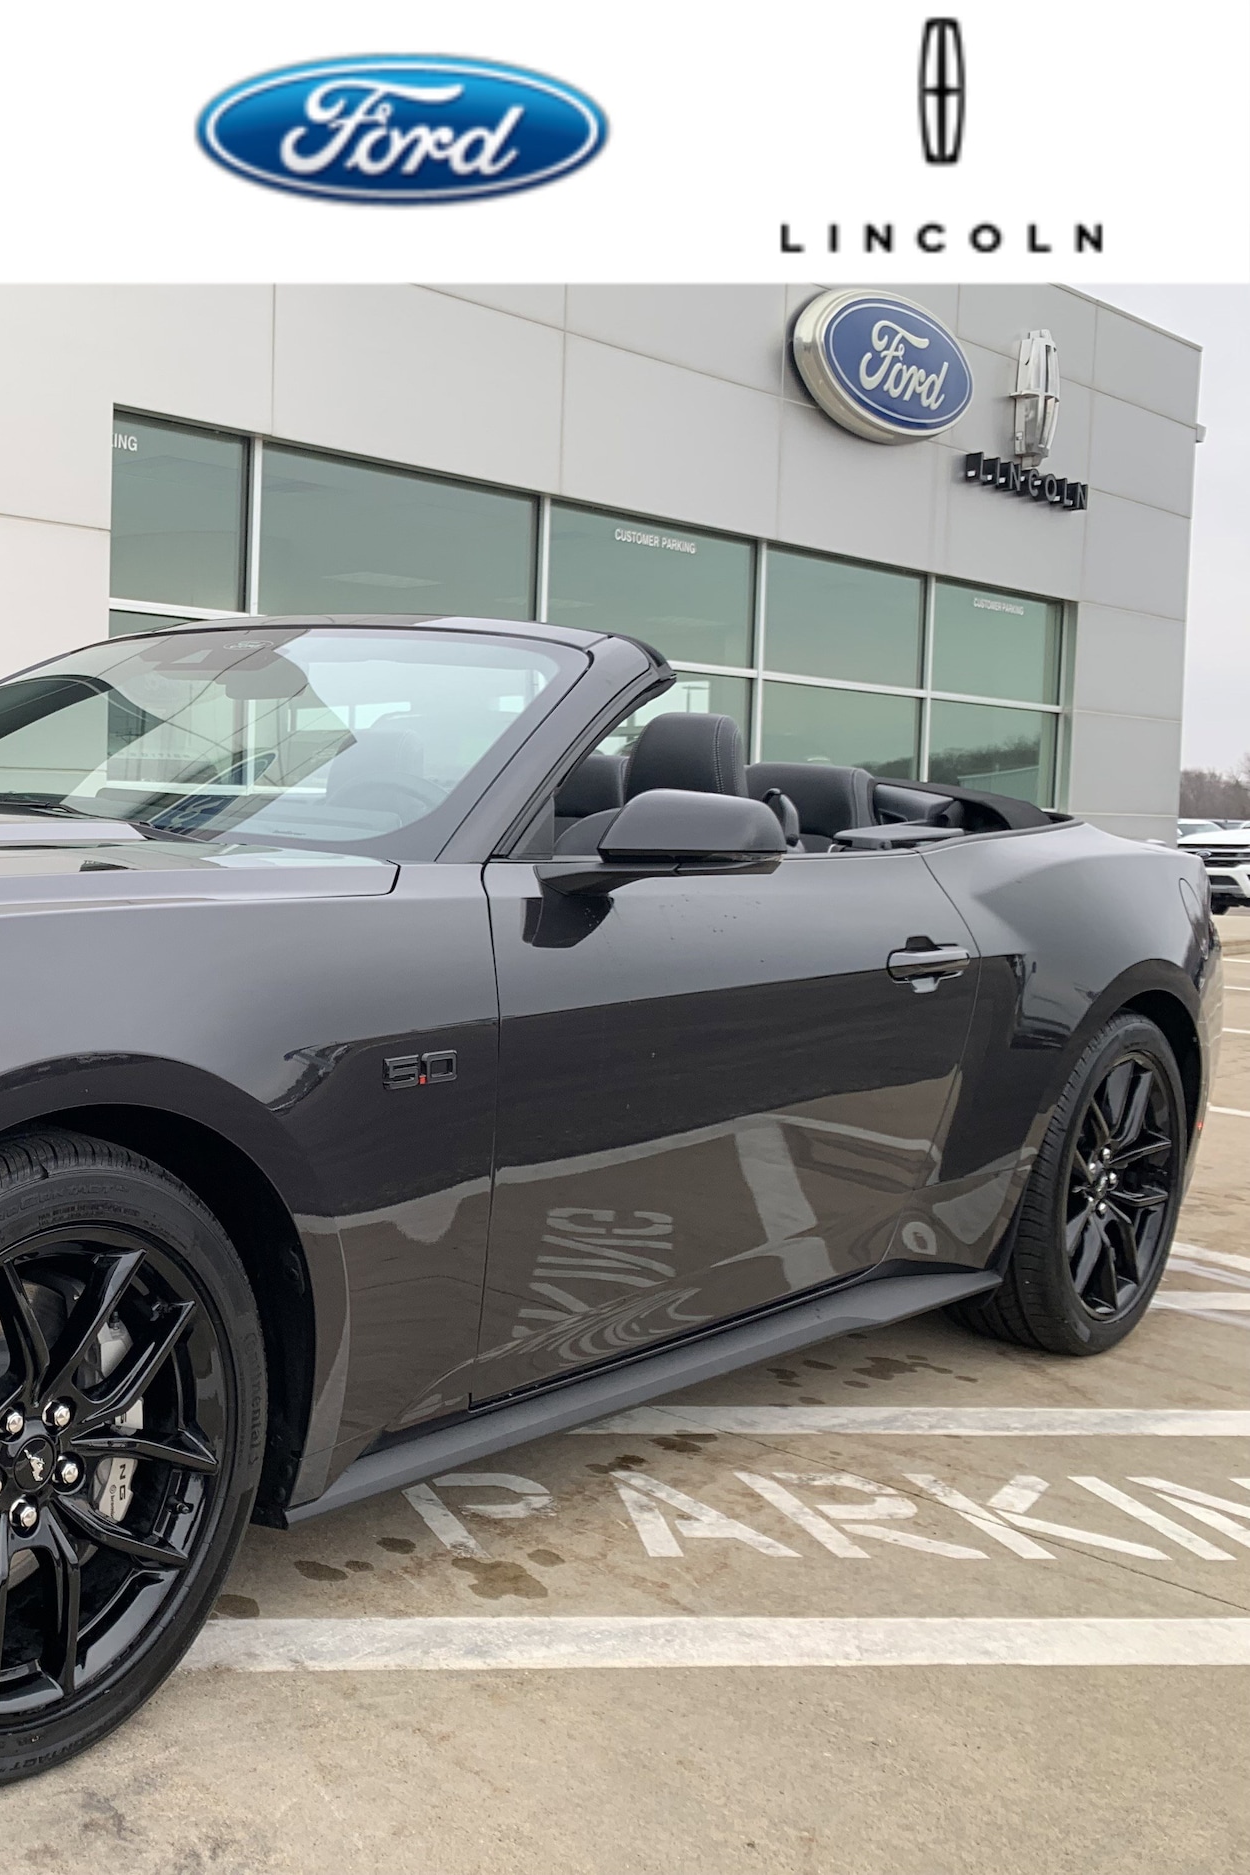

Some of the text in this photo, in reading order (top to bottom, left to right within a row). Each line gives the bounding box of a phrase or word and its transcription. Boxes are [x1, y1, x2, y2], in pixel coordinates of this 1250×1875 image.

[859, 320, 949, 410] Ford
[111, 433, 138, 451] ING
[965, 451, 1088, 511] LINCOLN
[614, 528, 696, 554] CUSTOMER PARKING
[382, 1049, 458, 1090] 5.0
